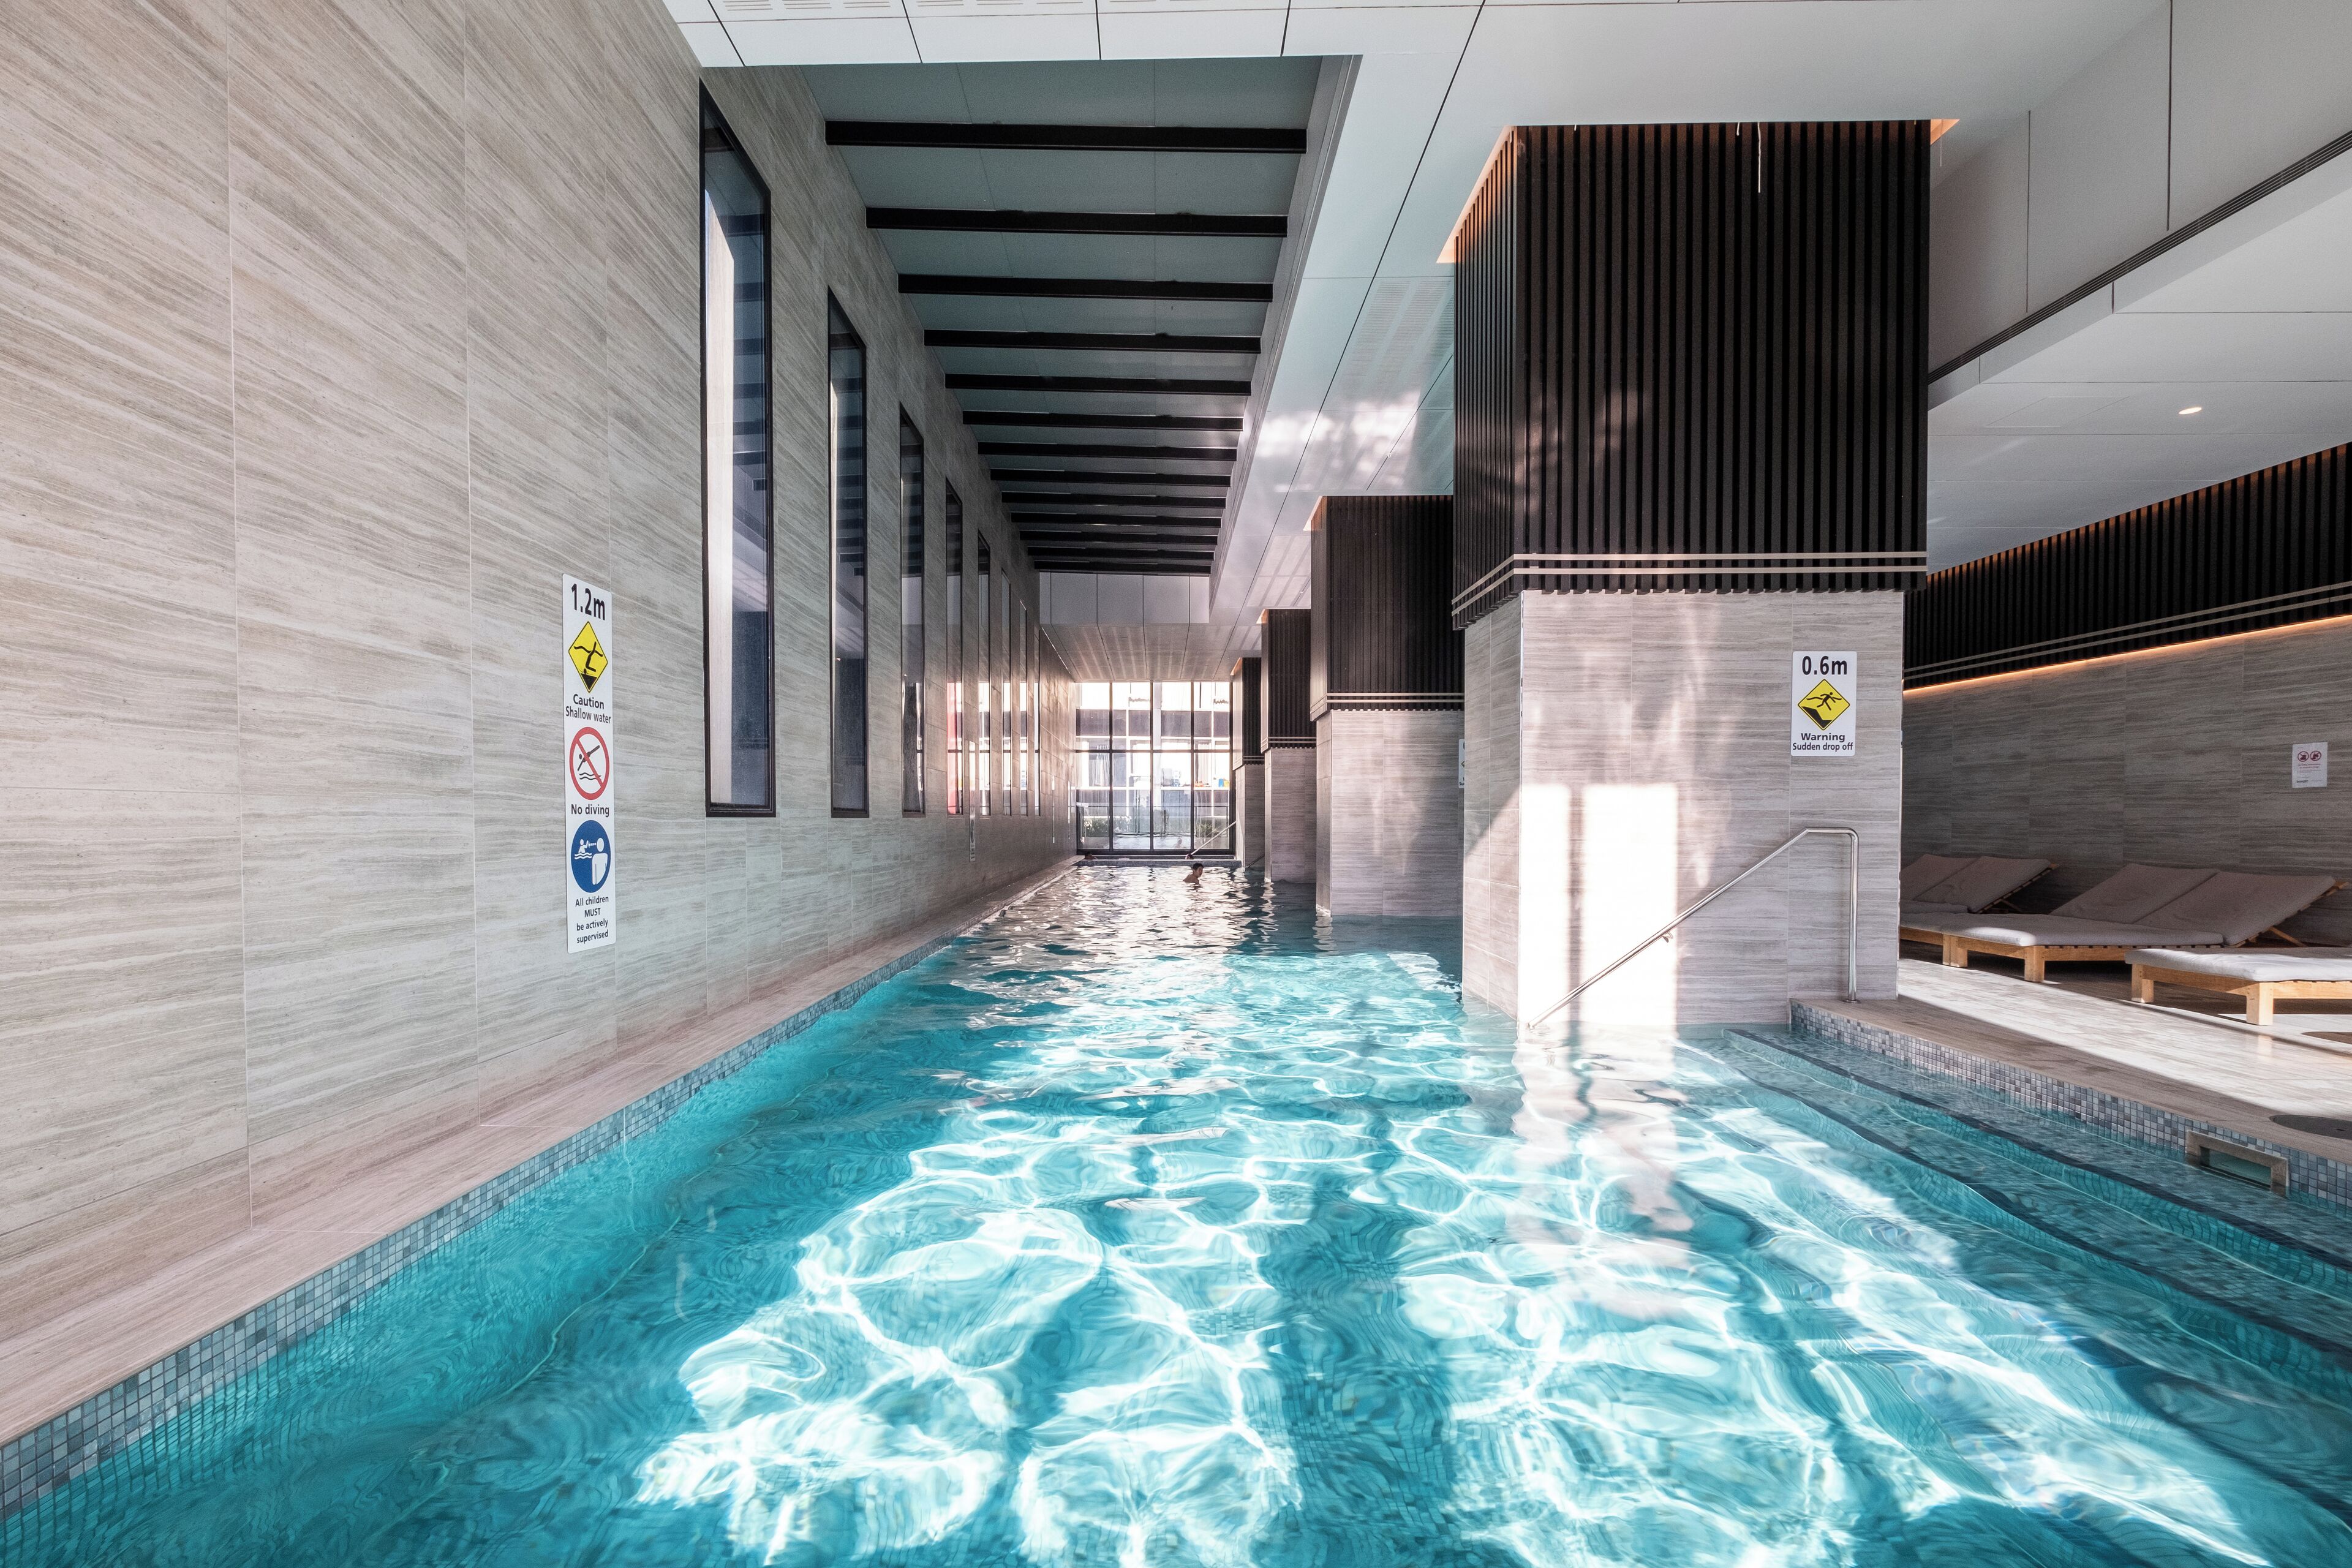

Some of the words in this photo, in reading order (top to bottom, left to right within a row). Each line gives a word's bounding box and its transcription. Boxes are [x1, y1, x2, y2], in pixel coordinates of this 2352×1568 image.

[571, 583, 605, 620] 1.2m
[1802, 655, 1847, 676] 0.6m
[573, 693, 605, 710] Caution
[565, 706, 592, 721] Shallow
[594, 713, 611, 724] water
[1801, 733, 1845, 743] Warning
[1822, 742, 1840, 752] drop
[571, 804, 582, 815] No
[585, 804, 609, 818] diving
[575, 898, 584, 907] All
[586, 895, 609, 905] children
[584, 907, 601, 918] MUST
[576, 923, 584, 932] be
[586, 918, 608, 929] actively
[576, 929, 609, 944] supervised
